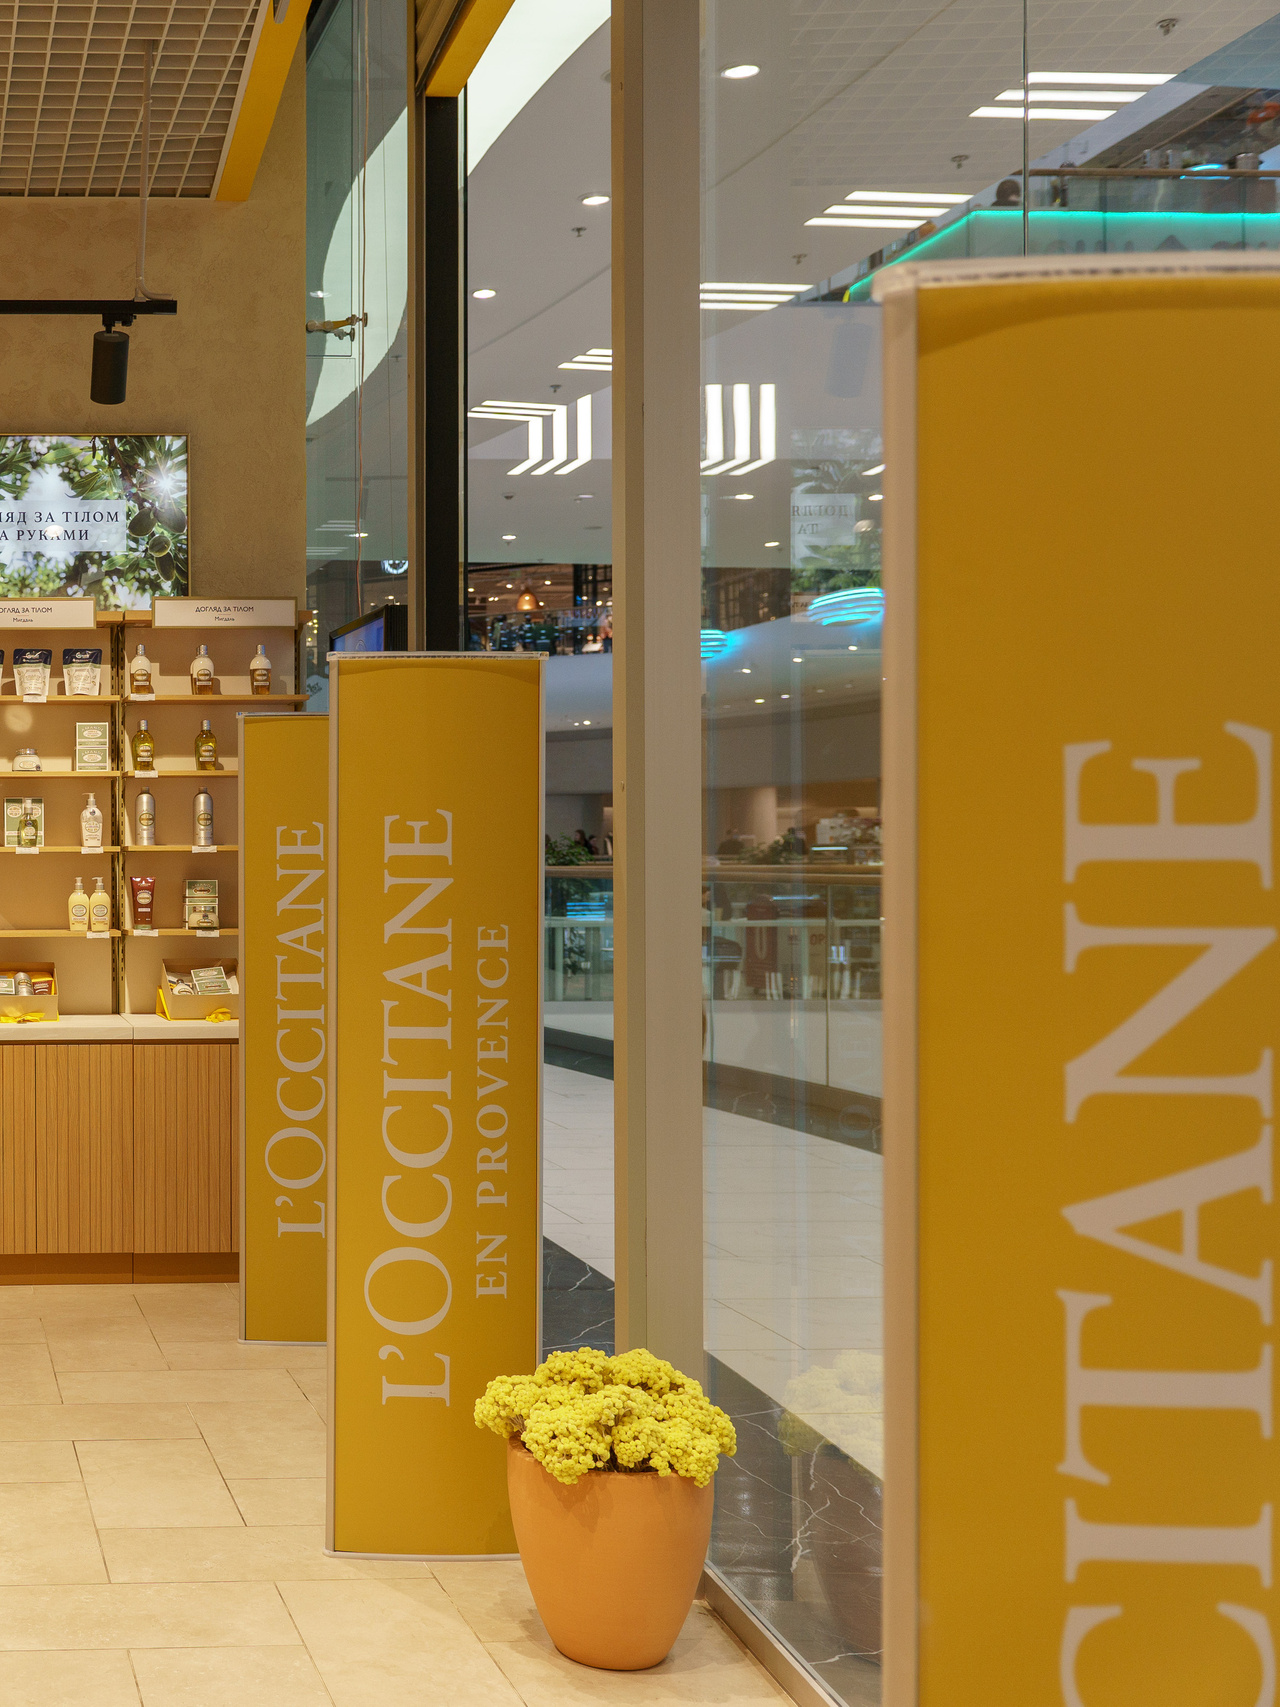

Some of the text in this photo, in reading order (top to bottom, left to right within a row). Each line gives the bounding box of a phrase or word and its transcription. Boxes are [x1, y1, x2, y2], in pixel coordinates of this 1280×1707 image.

[34, 511, 56, 523] ЗА
[61, 511, 120, 523] ТІЛОМ
[233, 605, 254, 613] ТІЛОМ
[264, 820, 327, 1239] L'OCCITANE
[363, 809, 454, 1407] L'OCCITANE
[475, 923, 510, 1299] EN PROVENCE
